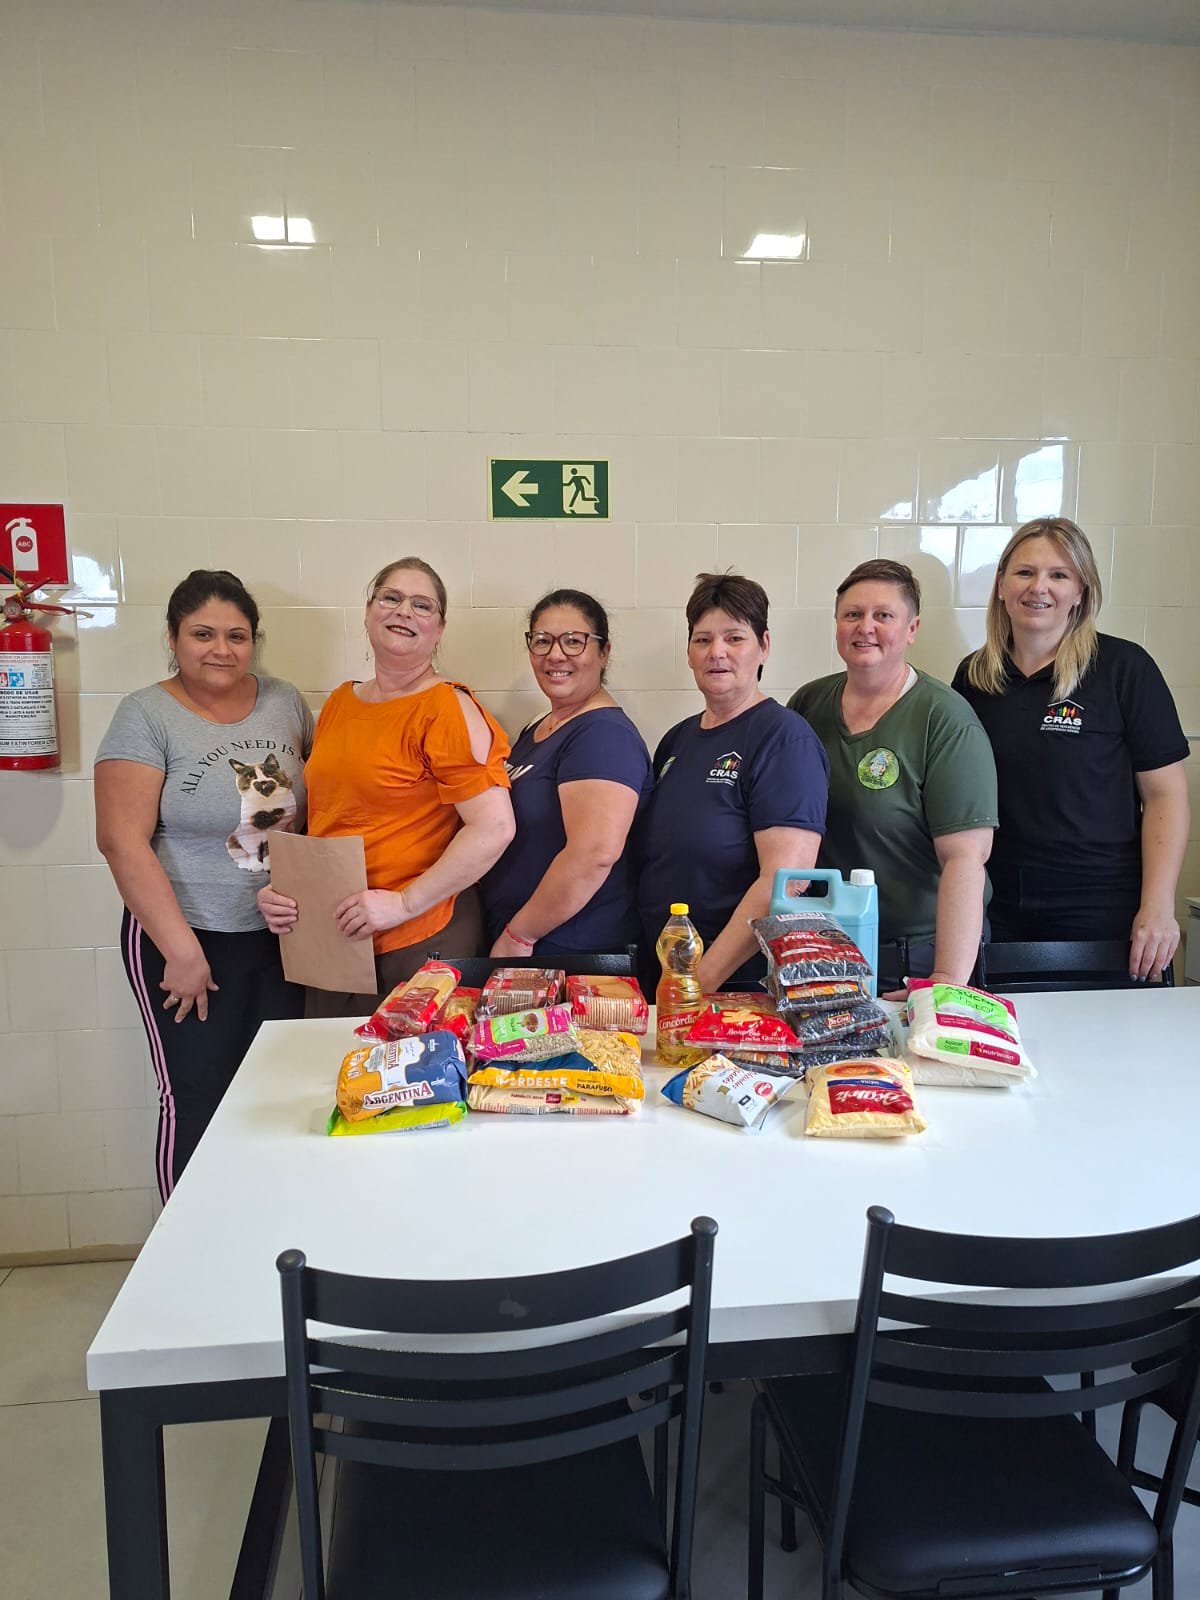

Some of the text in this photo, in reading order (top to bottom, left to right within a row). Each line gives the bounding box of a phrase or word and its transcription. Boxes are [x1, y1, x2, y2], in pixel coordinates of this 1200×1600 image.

[1043, 715, 1082, 726] CRAS
[180, 739, 296, 796] ALL YOU NEED IS
[709, 769, 739, 779] CRAS
[783, 934, 815, 942] Preto
[577, 1083, 613, 1092] PARAFUSO
[364, 1082, 432, 1106] ARGENTINA
